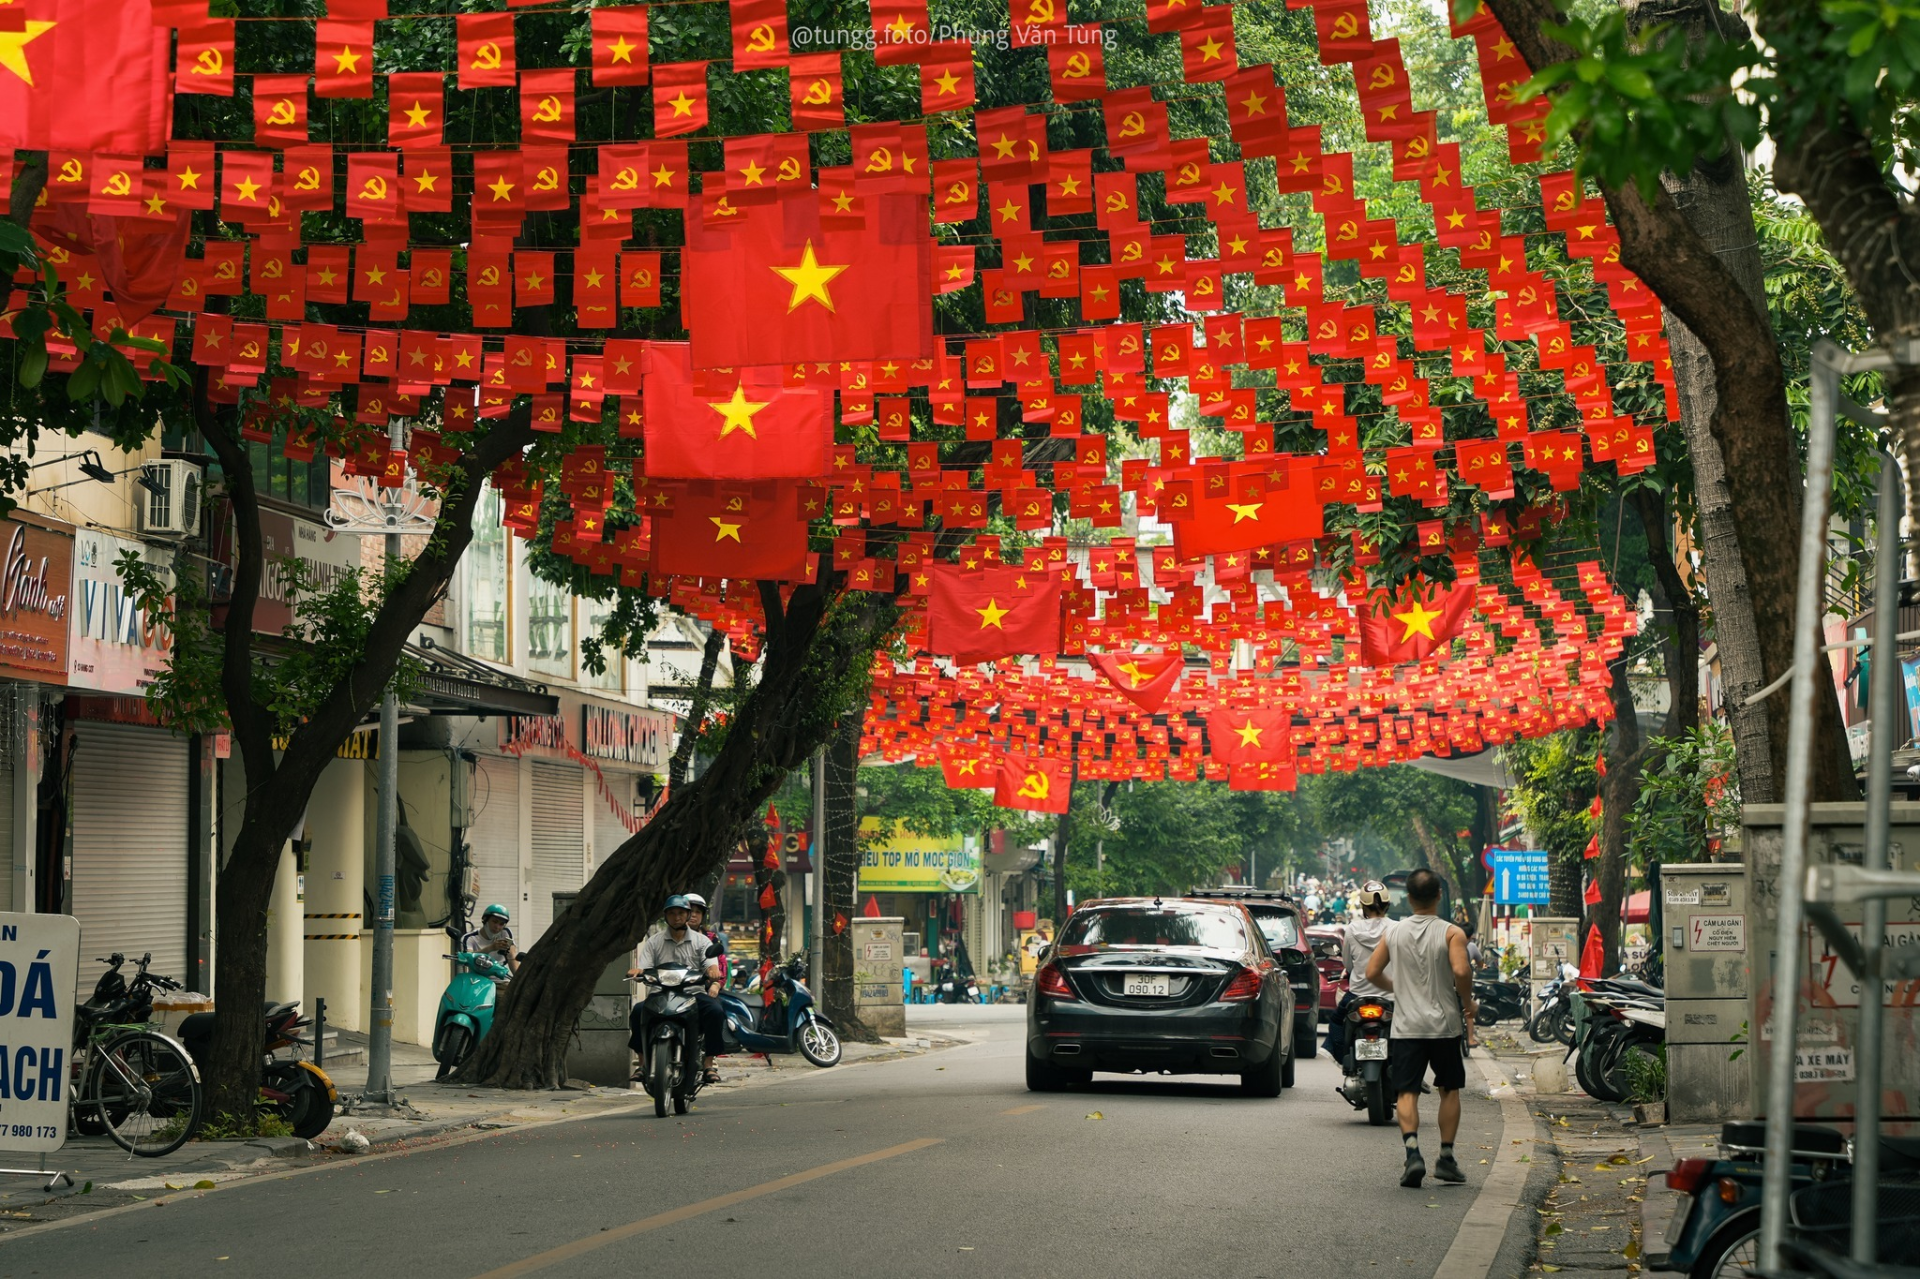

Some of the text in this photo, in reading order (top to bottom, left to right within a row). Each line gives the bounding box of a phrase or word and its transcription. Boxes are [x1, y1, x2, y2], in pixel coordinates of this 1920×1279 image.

[79, 579, 174, 651] VIVACO
[882, 846, 902, 867] TÓP
[947, 846, 970, 868] GIÒN
[0, 925, 17, 941] N
[1137, 974, 1157, 984] 30F
[1129, 984, 1165, 994] 090.12
[1807, 1055, 1822, 1066] XE
[11, 1124, 33, 1138] 980
[36, 1126, 57, 1138] 173
